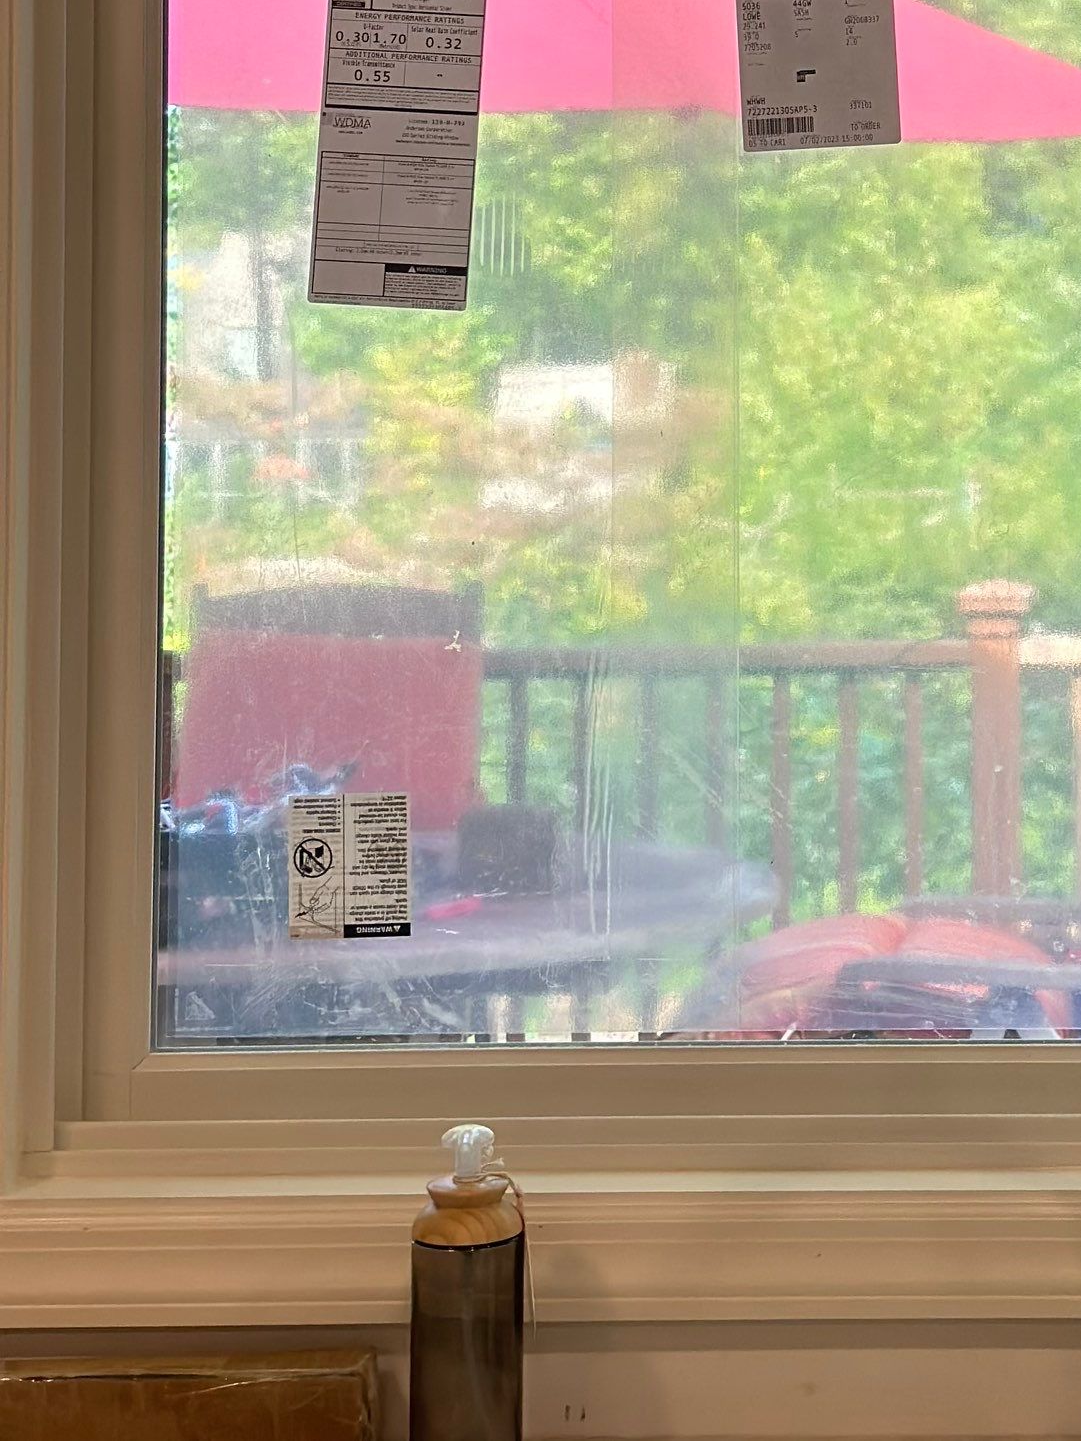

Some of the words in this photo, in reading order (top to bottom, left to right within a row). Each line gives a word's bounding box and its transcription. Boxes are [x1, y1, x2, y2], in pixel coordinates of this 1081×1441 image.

[355, 12, 381, 20] ENERGY
[384, 14, 431, 23] PERFORMANCE
[434, 16, 465, 24] RATINGS
[335, 30, 370, 43] 0.30
[373, 33, 407, 45] 1.70
[425, 37, 462, 50] 0.32
[345, 51, 388, 59] ADDITIONAL
[391, 53, 438, 62] PERFORMANCE
[354, 69, 391, 82] 0.55
[333, 116, 372, 129] WDMA
